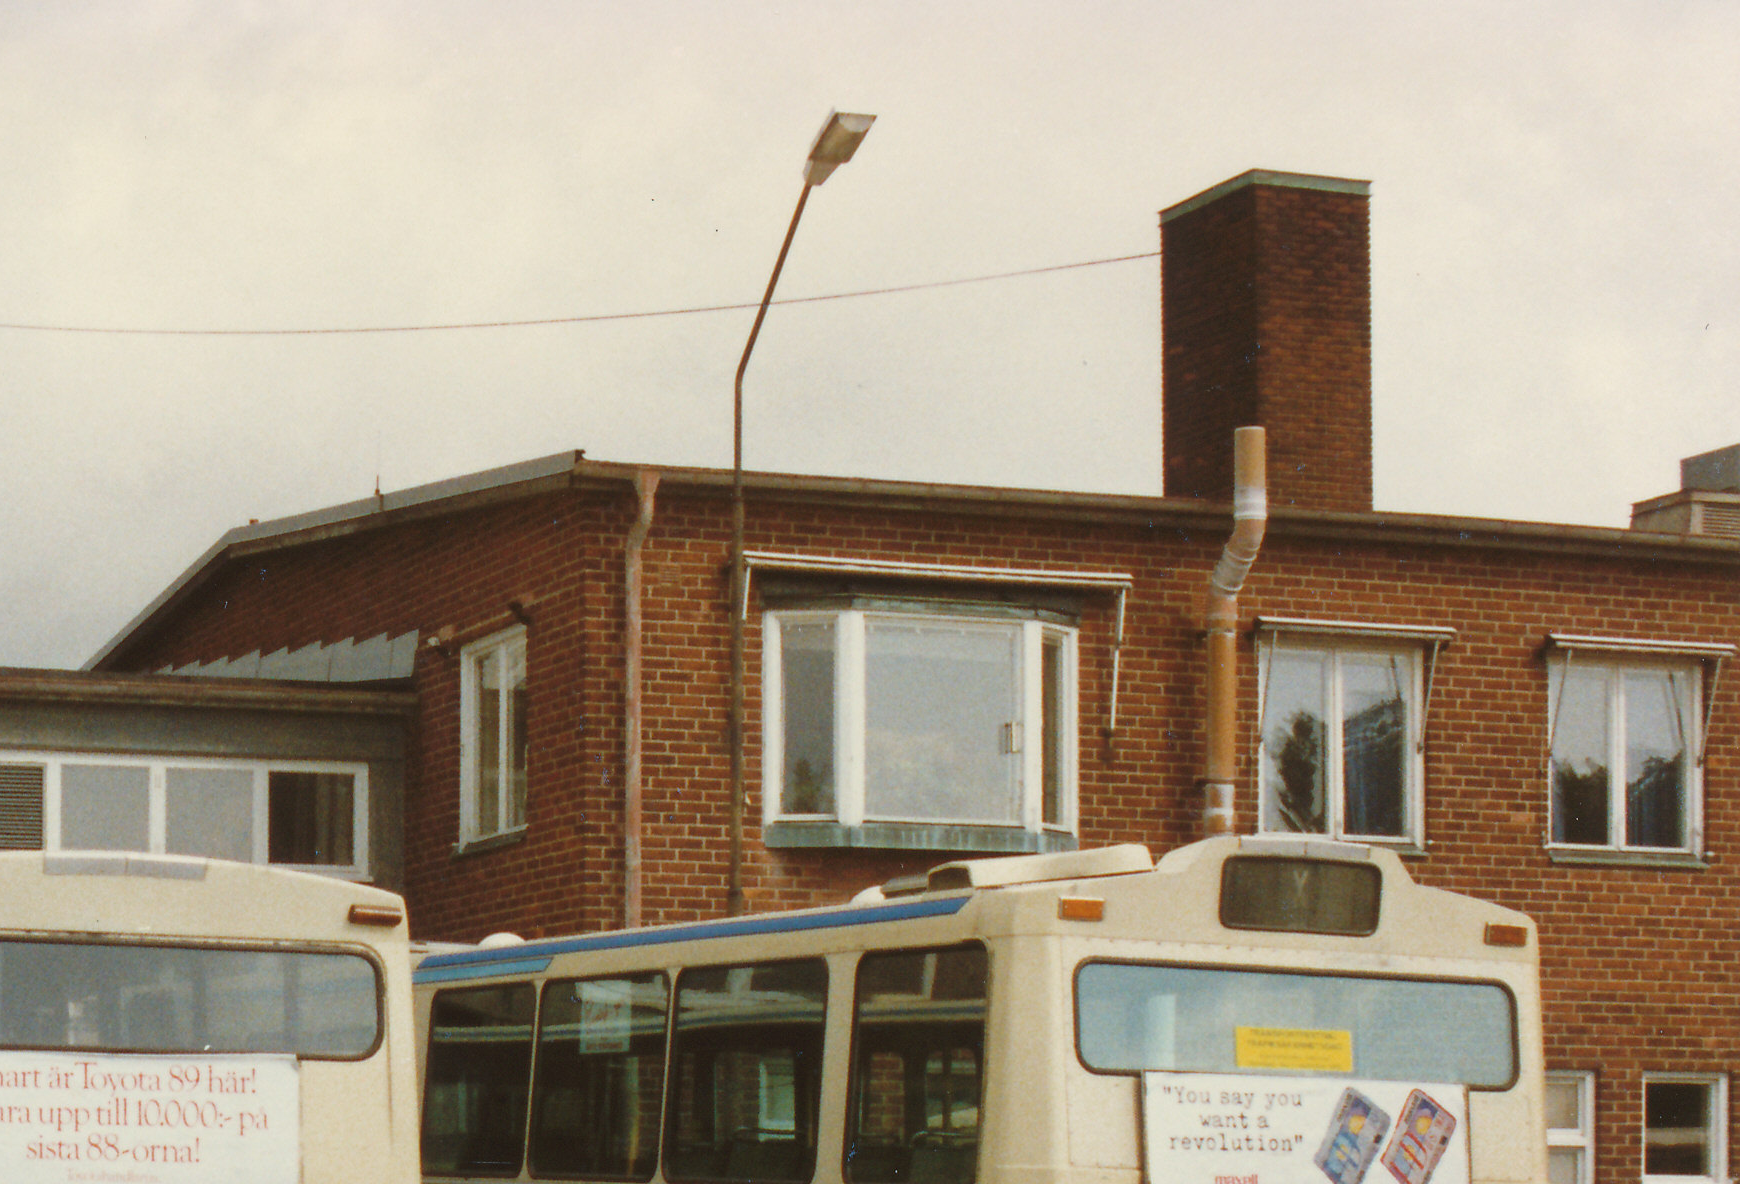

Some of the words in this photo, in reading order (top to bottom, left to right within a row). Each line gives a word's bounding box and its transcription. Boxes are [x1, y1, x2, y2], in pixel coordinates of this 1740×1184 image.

[48, 1065, 74, 1090] är
[74, 1061, 162, 1097] Toyota
[167, 1064, 201, 1093] 89
[208, 1064, 258, 1095] här!
[1162, 1085, 1210, 1104] "You
[1219, 1090, 1254, 1109] say
[1264, 1092, 1303, 1111] you
[38, 1105, 91, 1133] upp
[96, 1097, 129, 1127] till
[238, 1105, 270, 1137] på
[1198, 1112, 1250, 1129] want
[1256, 1115, 1270, 1129] a
[25, 1134, 81, 1162] sista
[85, 1132, 201, 1164] 88-orna!
[1169, 1133, 1304, 1152] revolution"
